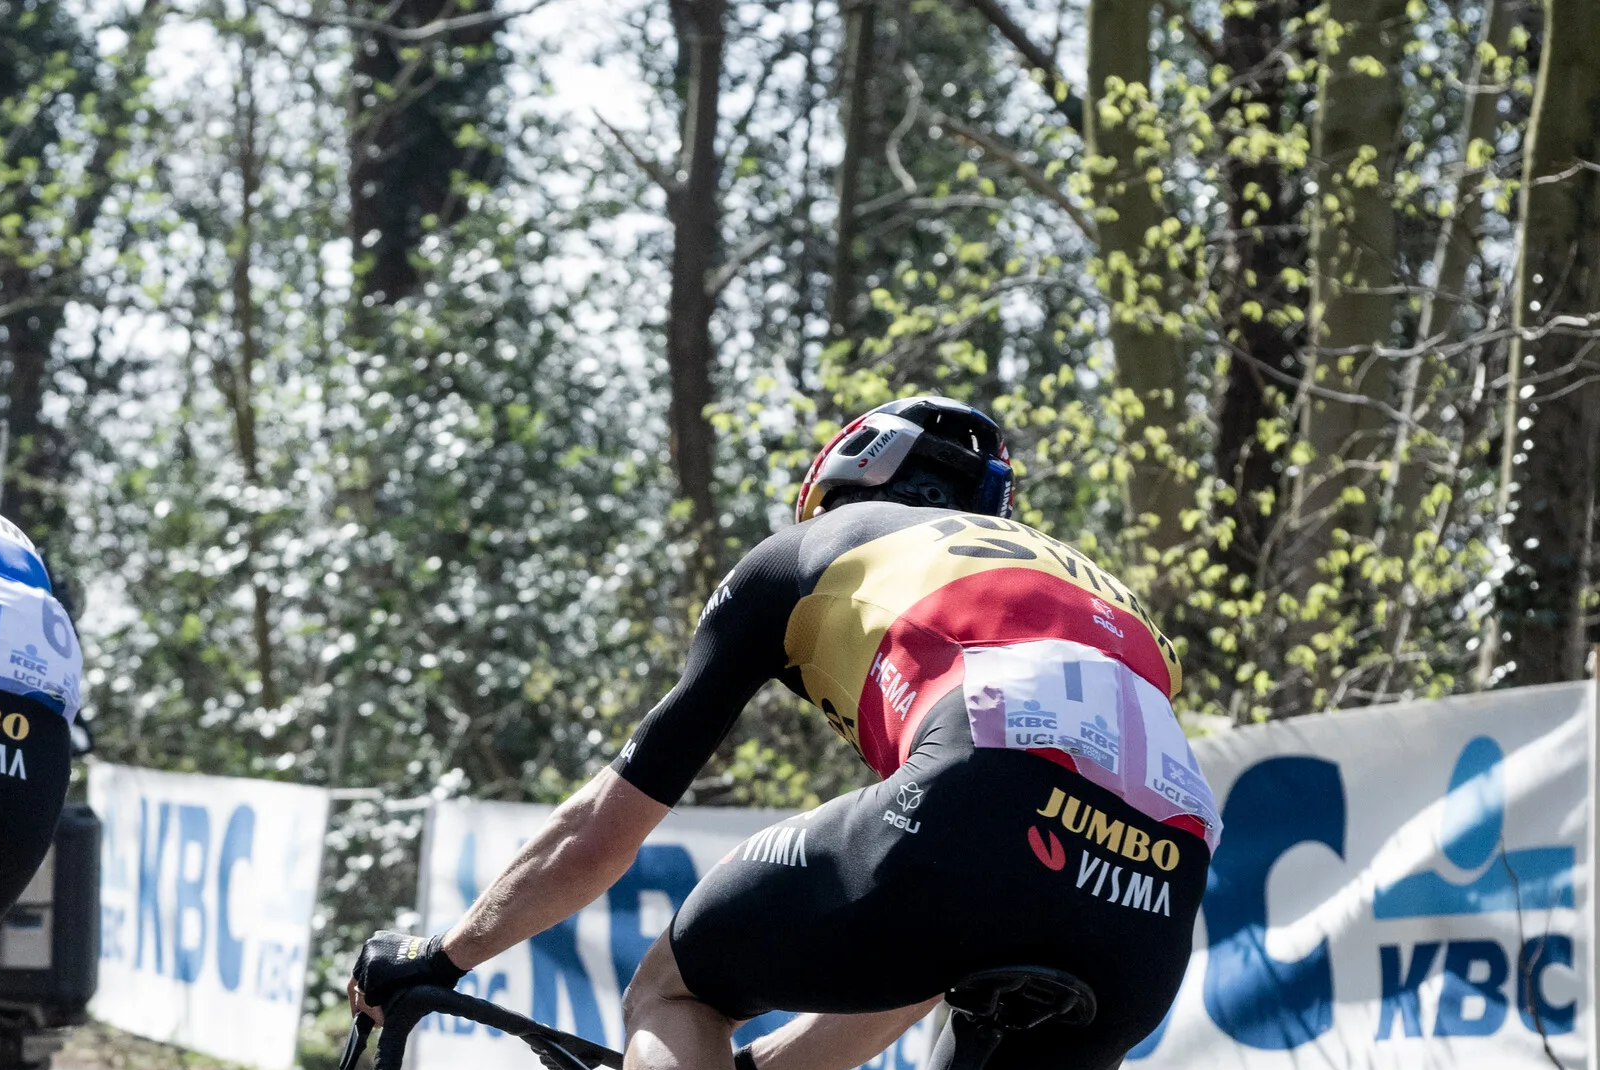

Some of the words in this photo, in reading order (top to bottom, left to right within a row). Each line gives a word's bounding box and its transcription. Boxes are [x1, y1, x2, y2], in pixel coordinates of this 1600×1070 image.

[867, 428, 898, 458] VISMA
[1092, 614, 1124, 639] AGU
[9, 652, 48, 676] KBC
[13, 669, 42, 687] UCI
[869, 651, 918, 722] HEMA
[1007, 716, 1058, 730] KBC
[1015, 733, 1054, 746] UCI
[1153, 778, 1181, 803] UCI
[882, 809, 921, 835] AGU
[1036, 786, 1180, 872] JUMBO
[742, 826, 808, 868] VISMA
[136, 797, 257, 992] KBC
[1075, 849, 1171, 917] VISMA
[1376, 932, 1578, 1041] KBC
